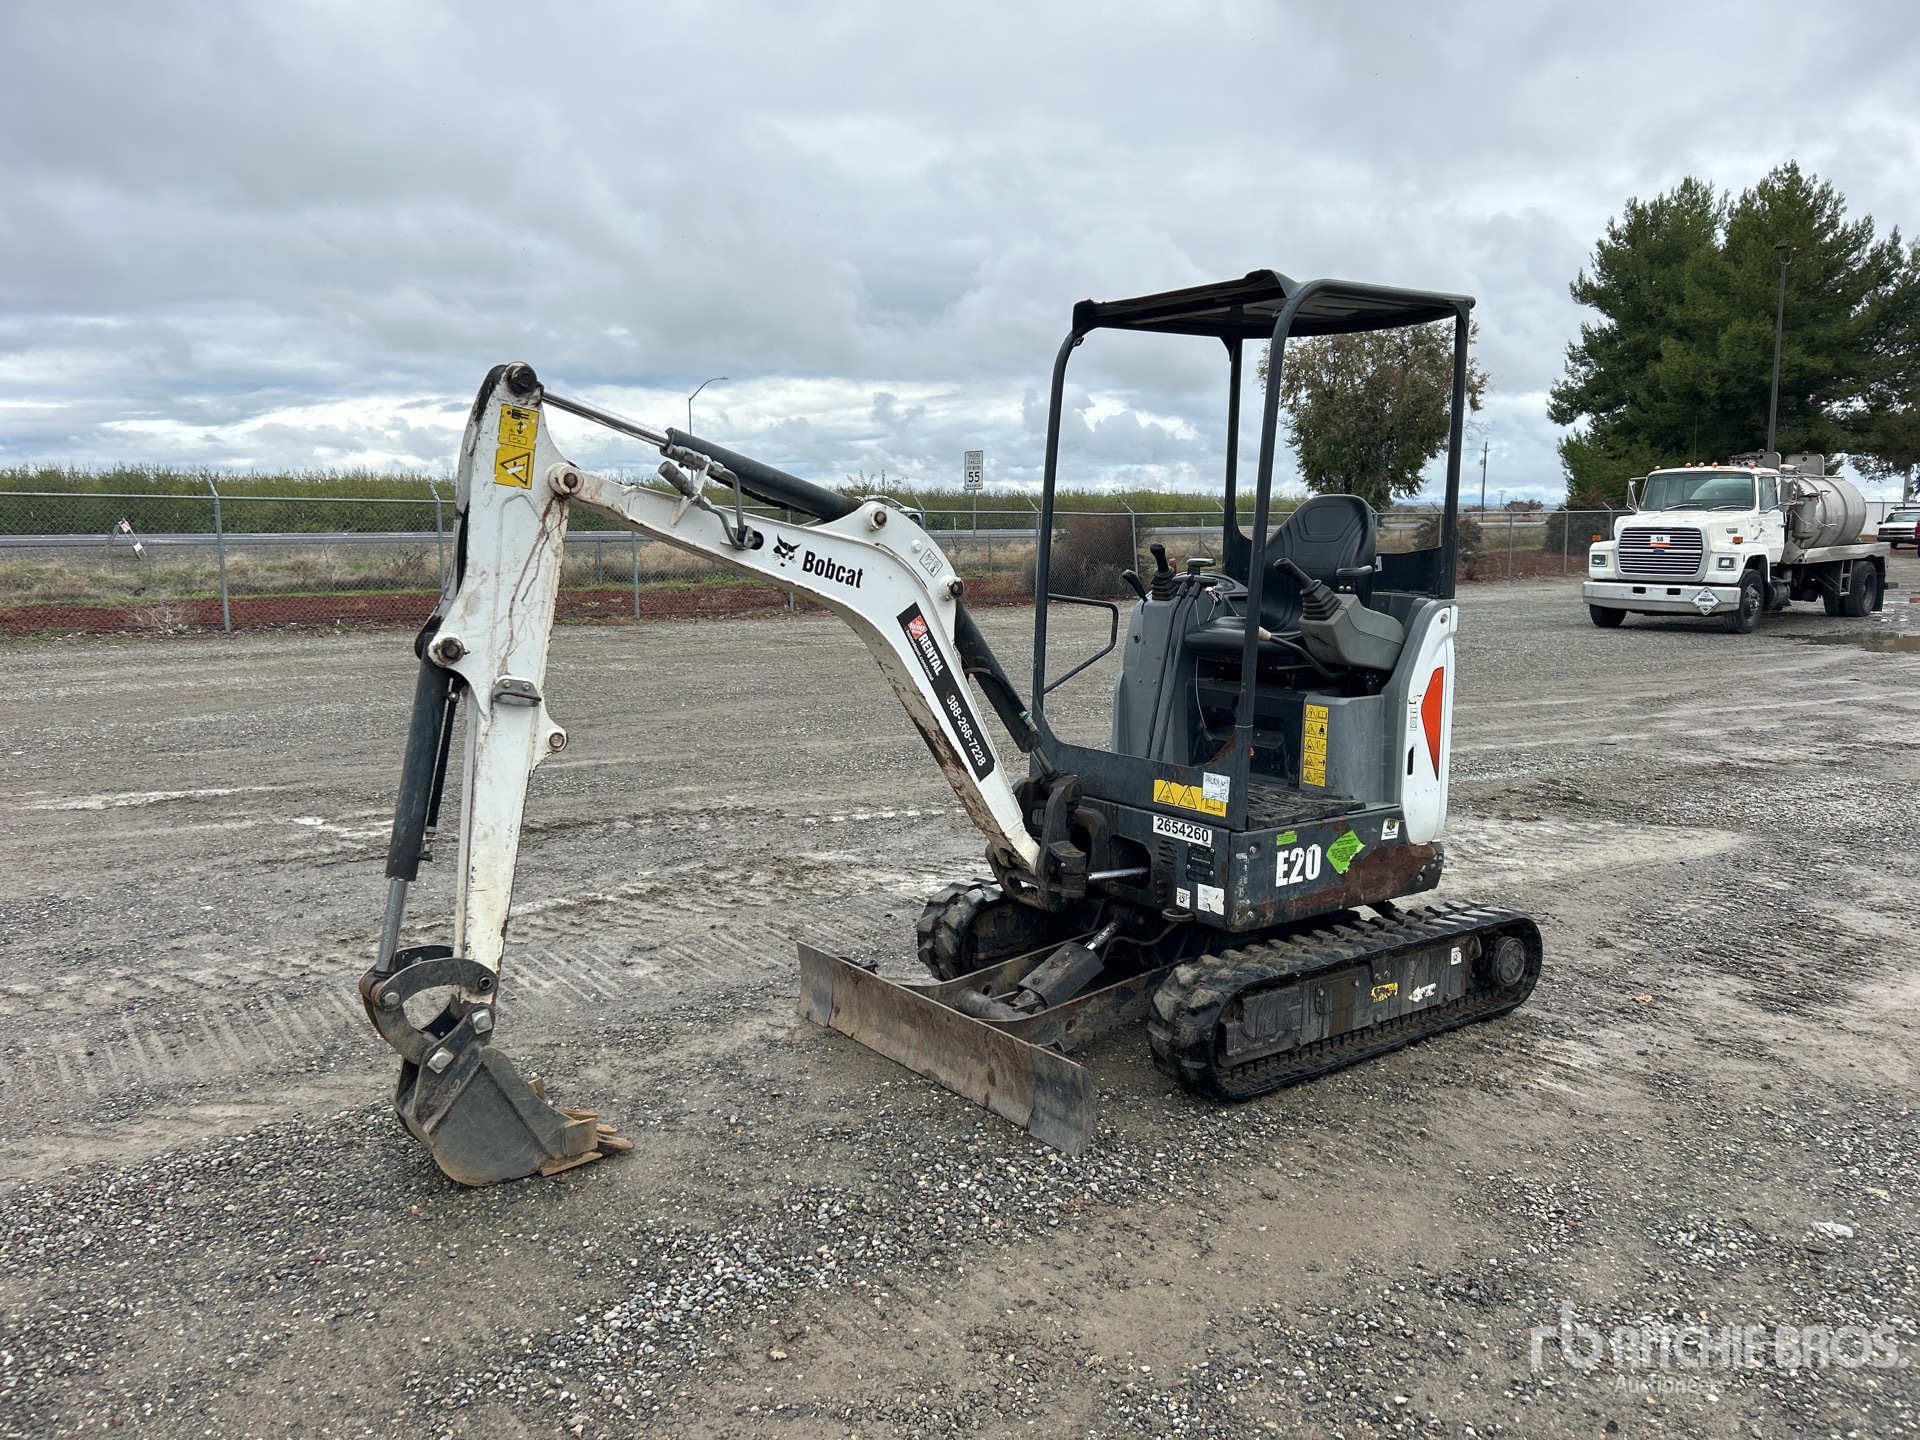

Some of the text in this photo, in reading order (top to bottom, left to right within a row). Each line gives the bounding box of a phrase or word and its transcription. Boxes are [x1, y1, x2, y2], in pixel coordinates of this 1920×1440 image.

[968, 472, 980, 482] 55
[802, 550, 863, 589] Bobcat
[919, 633, 944, 677] RENTAL
[1156, 817, 1209, 843] 2654260
[1276, 843, 1322, 888] E20
